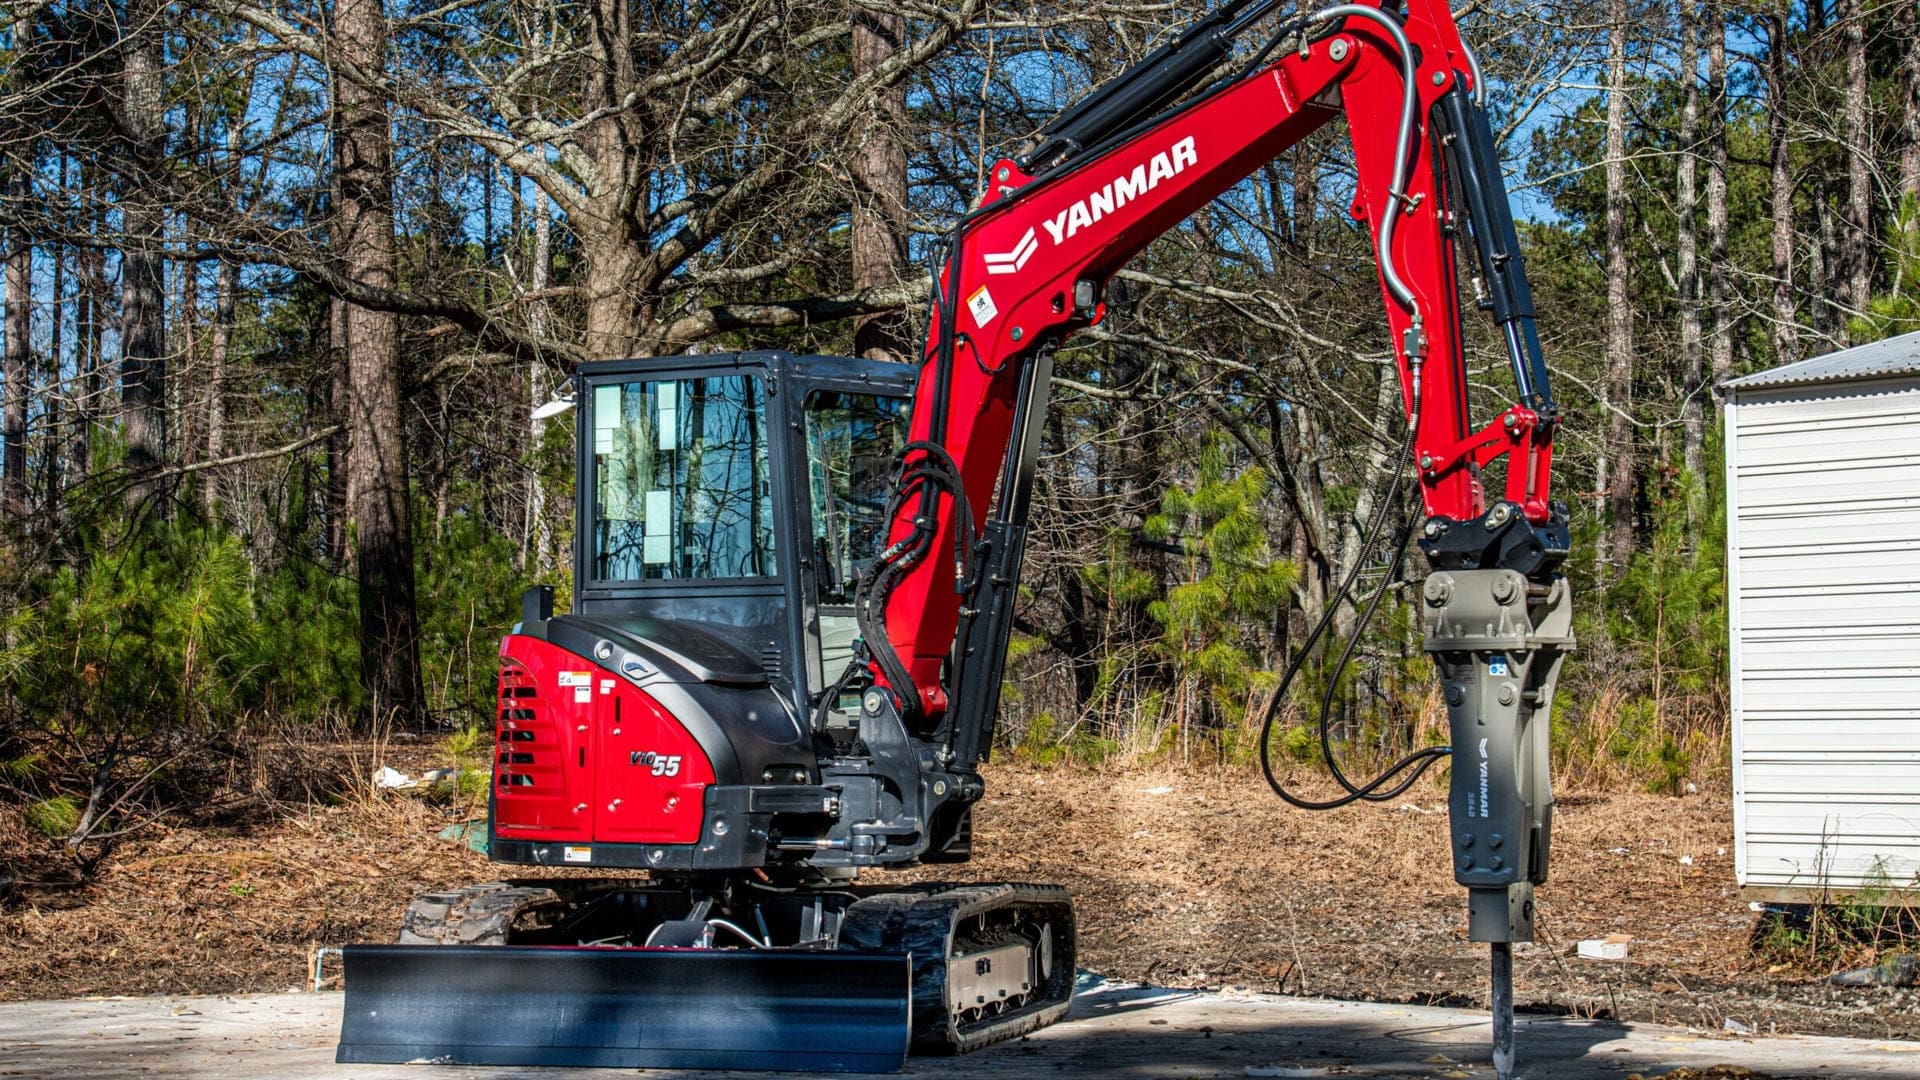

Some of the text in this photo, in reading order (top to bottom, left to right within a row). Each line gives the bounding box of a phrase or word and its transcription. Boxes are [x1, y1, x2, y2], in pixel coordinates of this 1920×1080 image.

[1042, 136, 1198, 246] YANMAR
[1467, 792, 1476, 818] SB40
[1480, 761, 1489, 818] YANMAR
